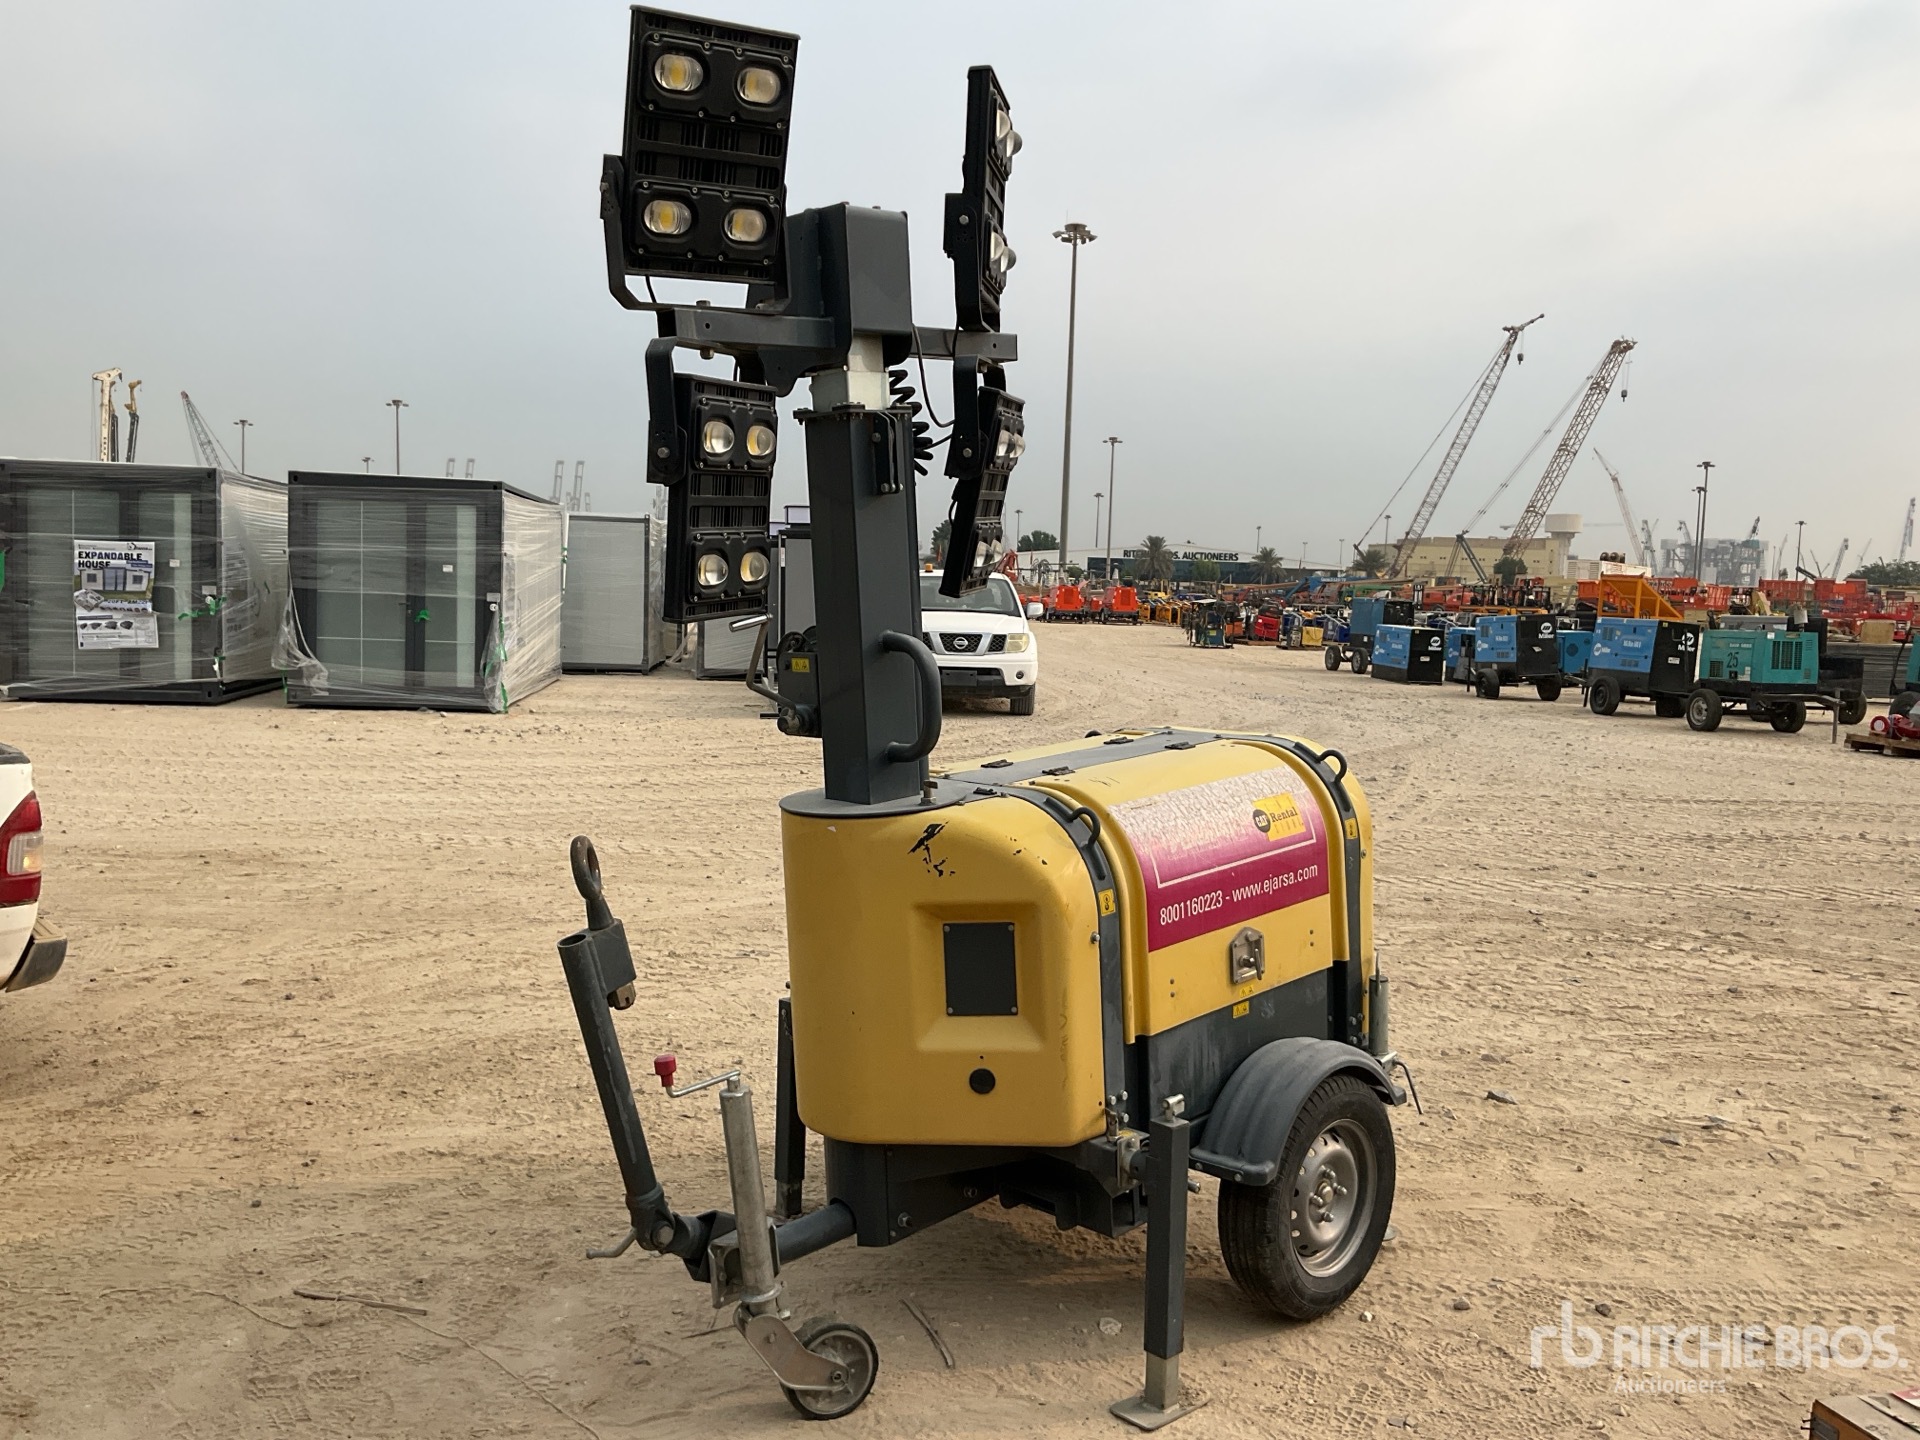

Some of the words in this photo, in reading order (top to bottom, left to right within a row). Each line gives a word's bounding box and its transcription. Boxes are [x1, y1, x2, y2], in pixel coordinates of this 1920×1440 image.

[78, 551, 142, 561] EXPANDABLE
[1182, 551, 1239, 561] AUCTIONEERS
[78, 560, 111, 569] HOUSE
[1726, 652, 1739, 668] 25
[1255, 814, 1268, 828] CAT
[1269, 806, 1298, 823] Rental
[1160, 890, 1223, 926] 8001160223
[1232, 864, 1318, 903] www.ejarsa.com
